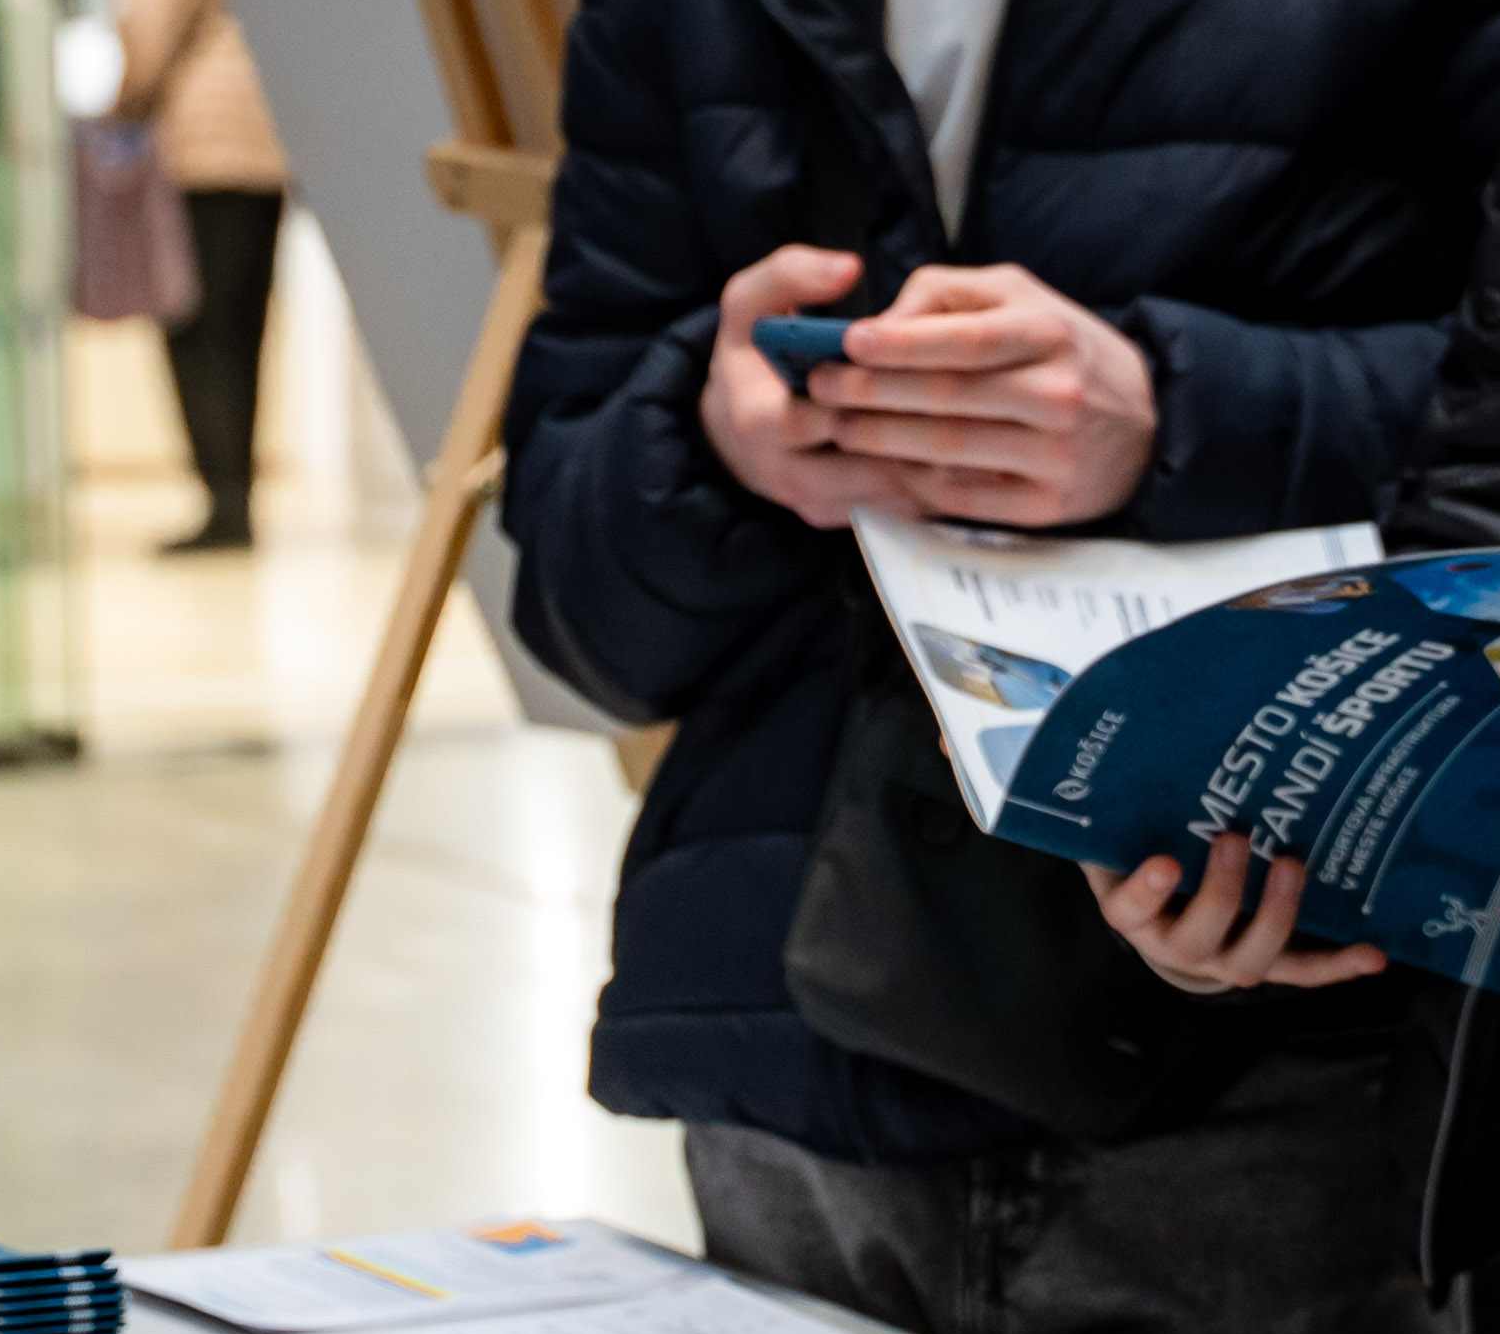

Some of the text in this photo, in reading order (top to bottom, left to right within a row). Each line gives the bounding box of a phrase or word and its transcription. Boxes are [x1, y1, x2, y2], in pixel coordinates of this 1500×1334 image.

[1069, 707, 1128, 783] KOŠICE
[1187, 627, 1401, 845] MESTO KOŠICE
[1248, 639, 1457, 863] FANDÍ ŠPORTU
[1341, 870, 1360, 891] V
